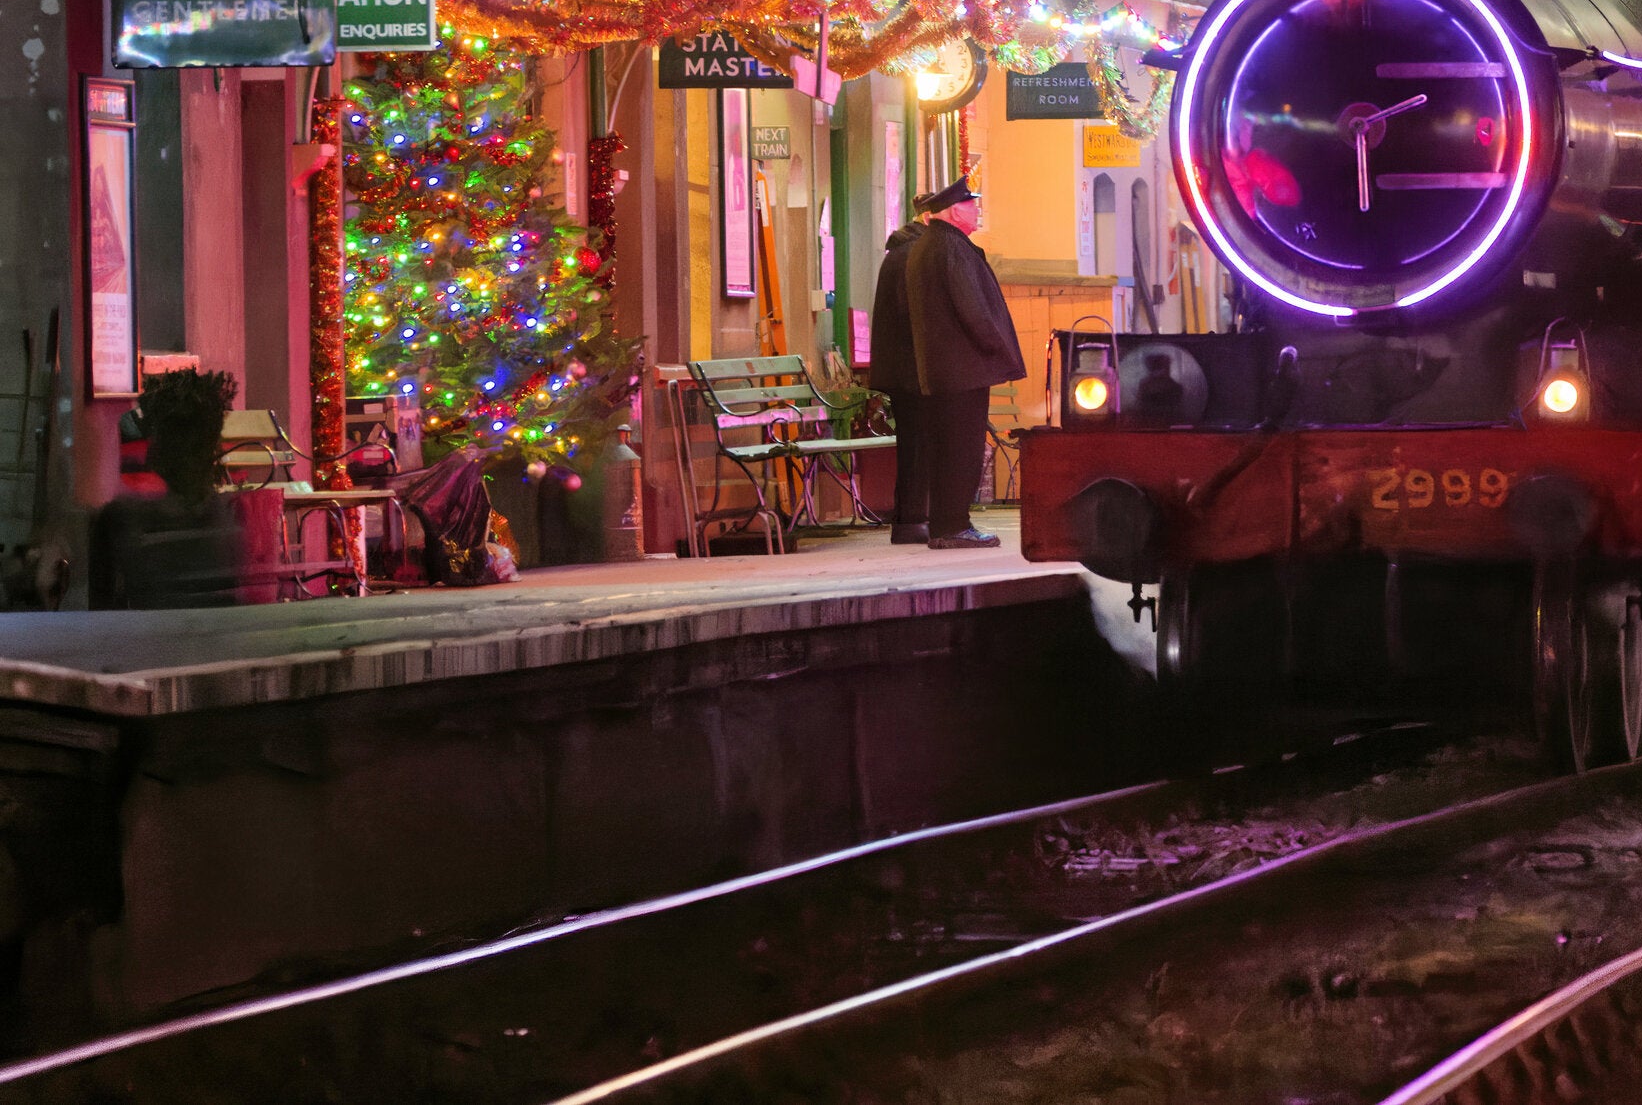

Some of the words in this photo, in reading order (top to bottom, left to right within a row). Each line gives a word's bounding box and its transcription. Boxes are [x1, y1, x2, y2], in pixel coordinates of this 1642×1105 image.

[340, 23, 427, 40] ENQUIRIES
[1039, 95, 1080, 105] ROOM
[756, 127, 787, 141] NEXT
[754, 143, 788, 157] TRAIN
[1367, 467, 1509, 510] 2999
